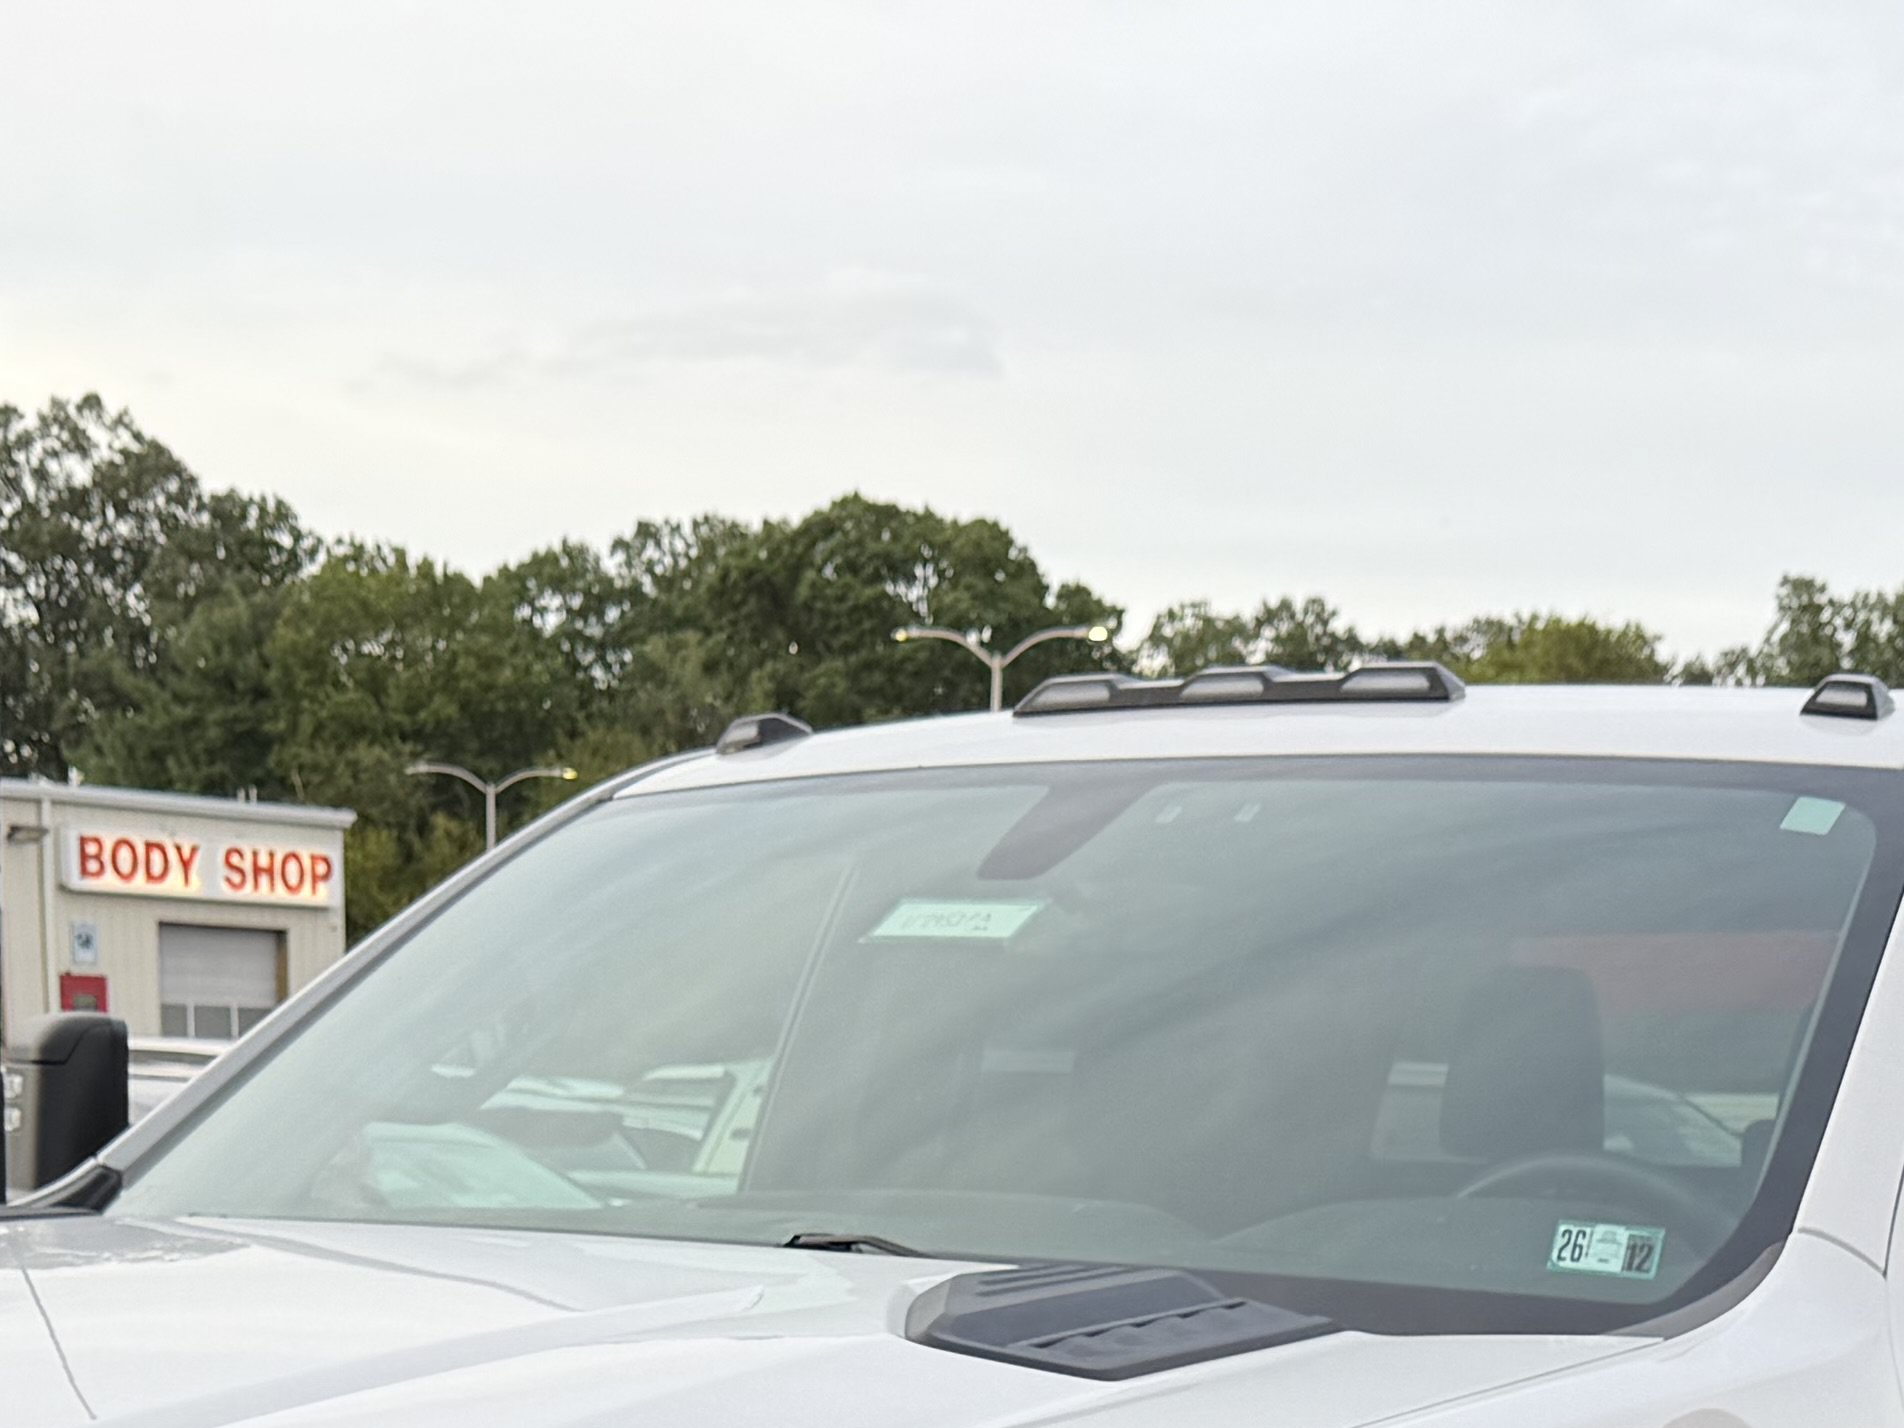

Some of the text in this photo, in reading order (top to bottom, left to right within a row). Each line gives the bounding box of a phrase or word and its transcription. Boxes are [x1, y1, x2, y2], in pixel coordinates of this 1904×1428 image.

[78, 834, 333, 896] BODY SHOP
[1556, 1228, 1654, 1274] 26 12
